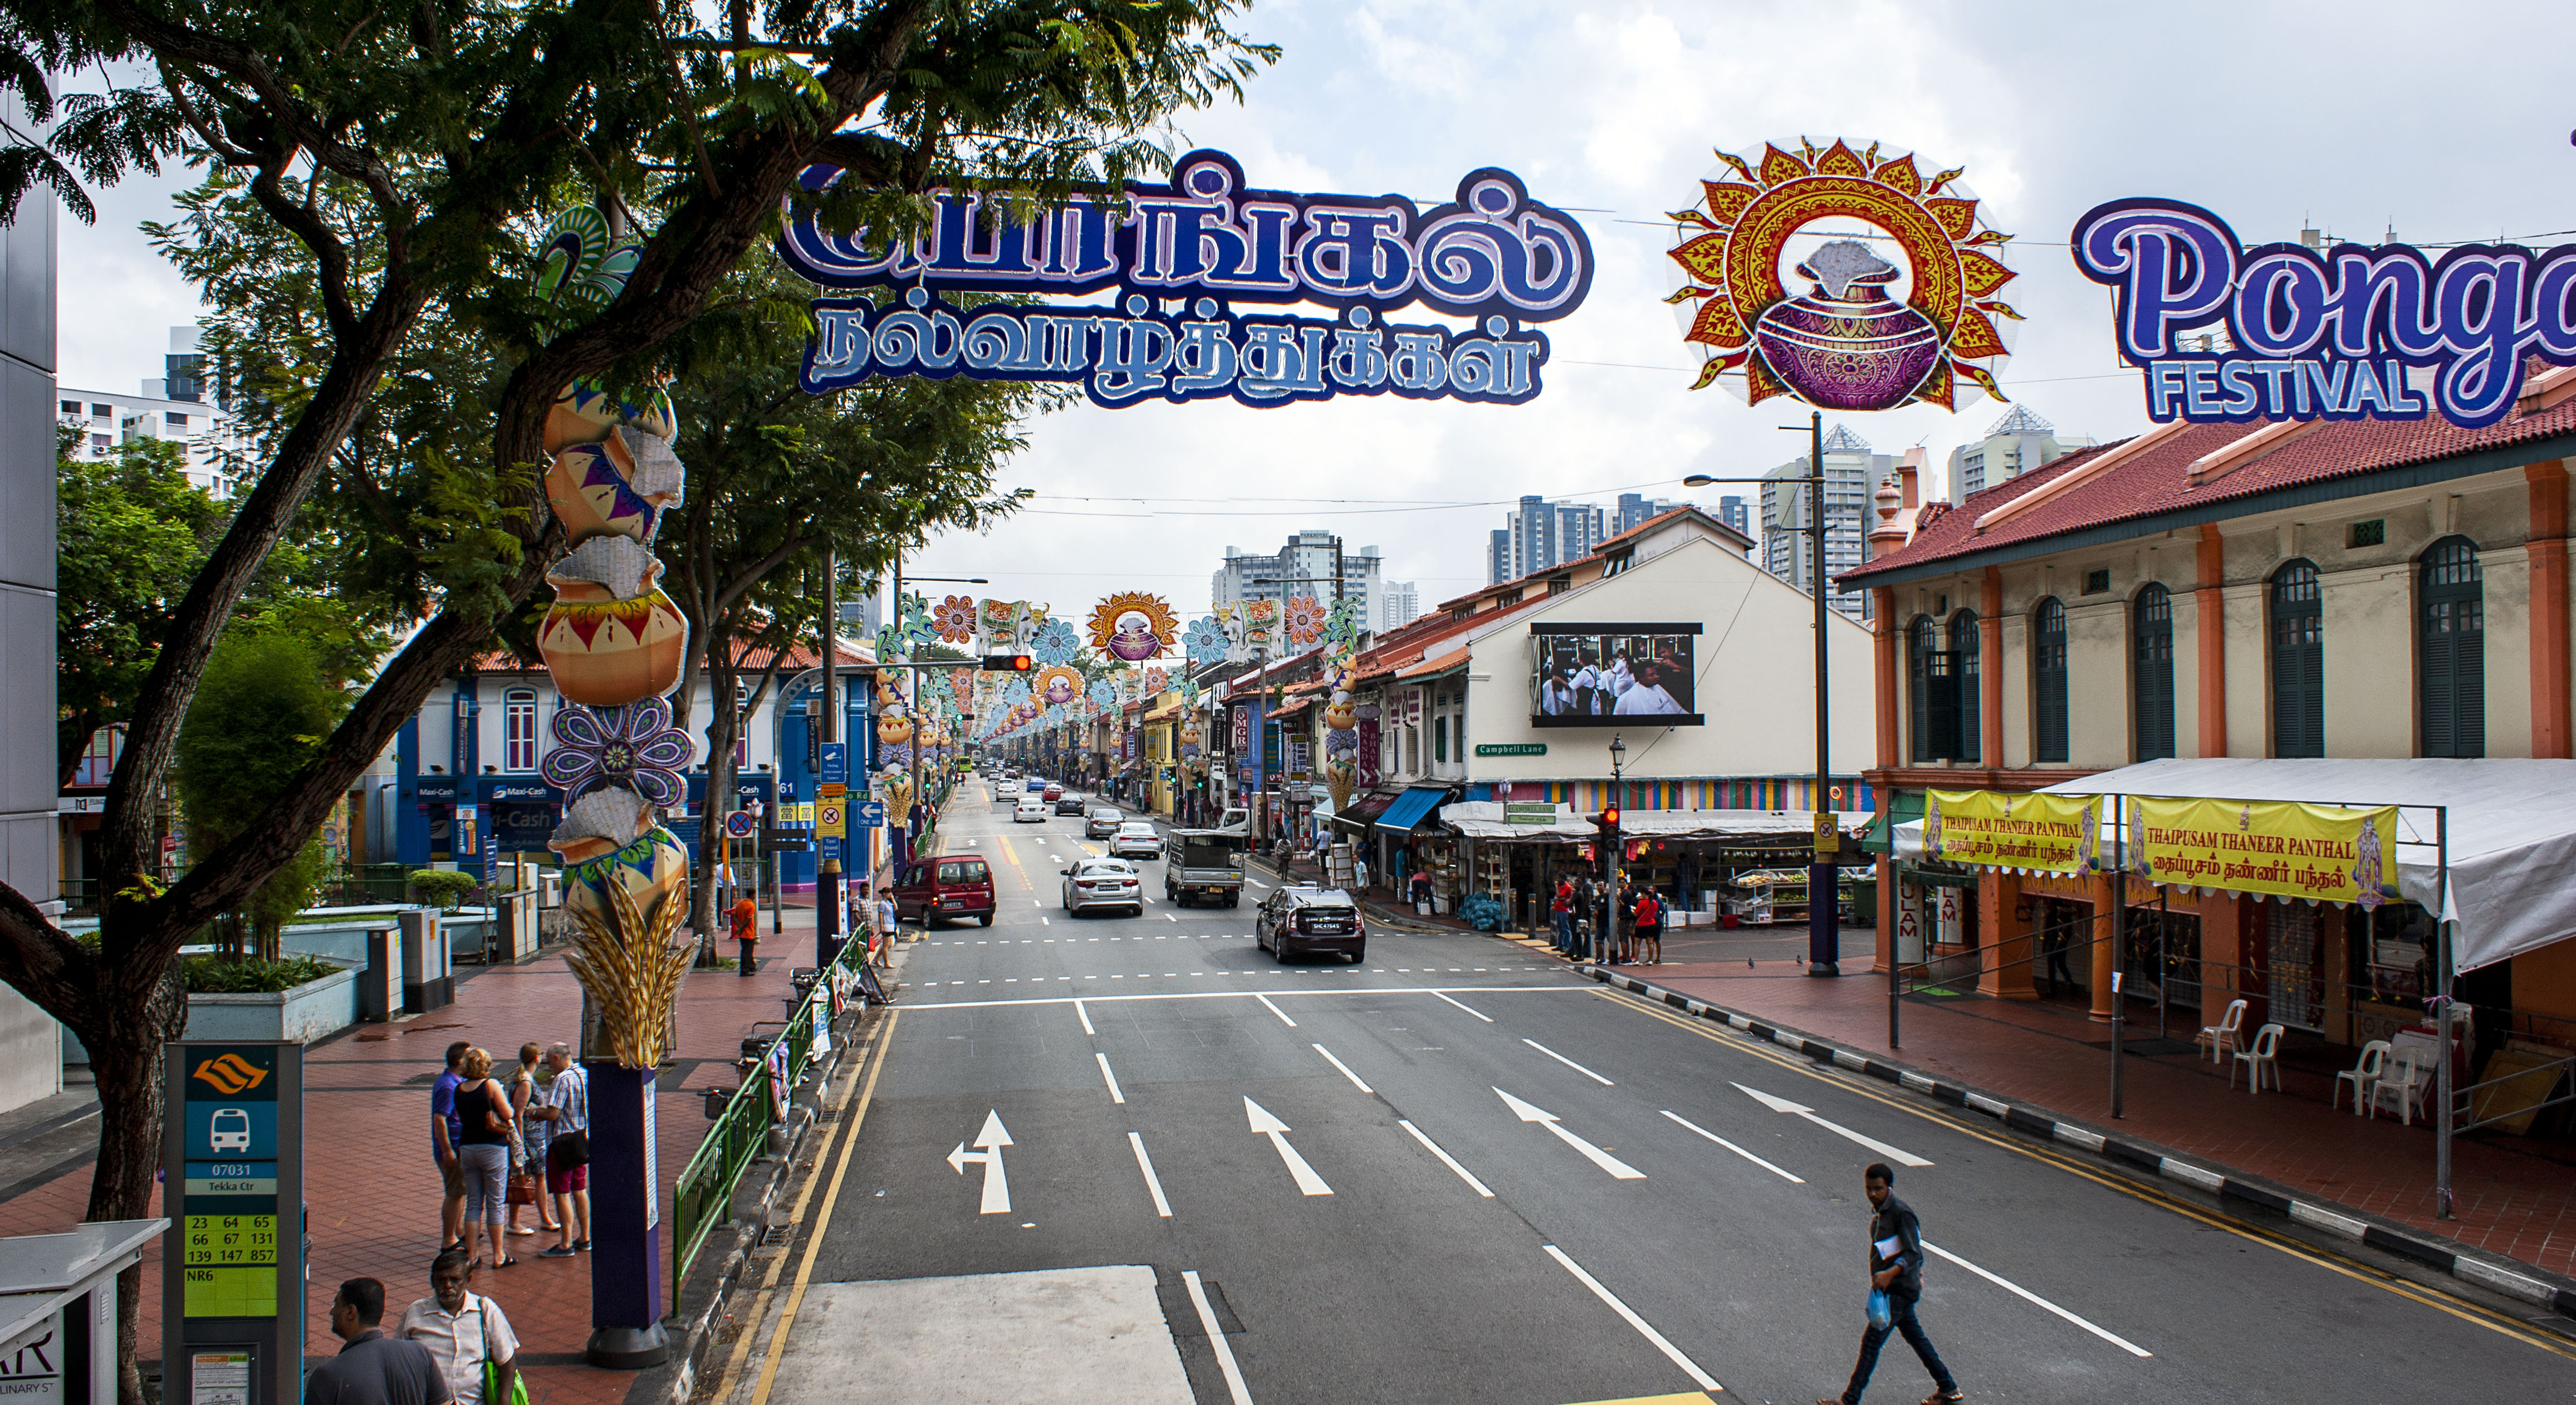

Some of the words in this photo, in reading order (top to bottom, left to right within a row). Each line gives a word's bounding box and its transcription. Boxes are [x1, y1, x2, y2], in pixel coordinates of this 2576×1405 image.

[2151, 359, 2425, 415] FESTIVAL
[1480, 746, 1520, 754] Campbell
[507, 787, 547, 795] Maxi-Cash
[780, 782, 794, 794] 61
[1944, 816, 1991, 831] THAIPUSAM
[1994, 819, 2034, 835] THANEER
[2036, 822, 2082, 838] PANTHAL
[1946, 835, 1993, 857] தைப்பூசம்
[1995, 838, 2038, 859] தண்ணீர்
[2040, 841, 2075, 865] பந்தல்
[2148, 828, 2218, 849] THAIPUSAM
[2221, 833, 2284, 854] THANEER
[2288, 838, 2355, 860] PANTHAL
[2153, 851, 2221, 879] தைப்பூசம்
[2224, 856, 2289, 882] தண்ணீர்
[2295, 863, 2346, 892] பந்தல்
[212, 1164, 251, 1176] 07031
[209, 1182, 237, 1191] Tekka
[240, 1182, 254, 1191] Ctr
[192, 1217, 208, 1228] 23
[223, 1216, 239, 1228] 64
[254, 1216, 270, 1227] 65
[193, 1234, 208, 1245] 66
[224, 1233, 239, 1244] 67
[251, 1233, 272, 1244] 131
[189, 1251, 212, 1262] 139
[221, 1250, 243, 1261] 147
[251, 1250, 274, 1261] 857
[187, 1270, 213, 1281] NR6
